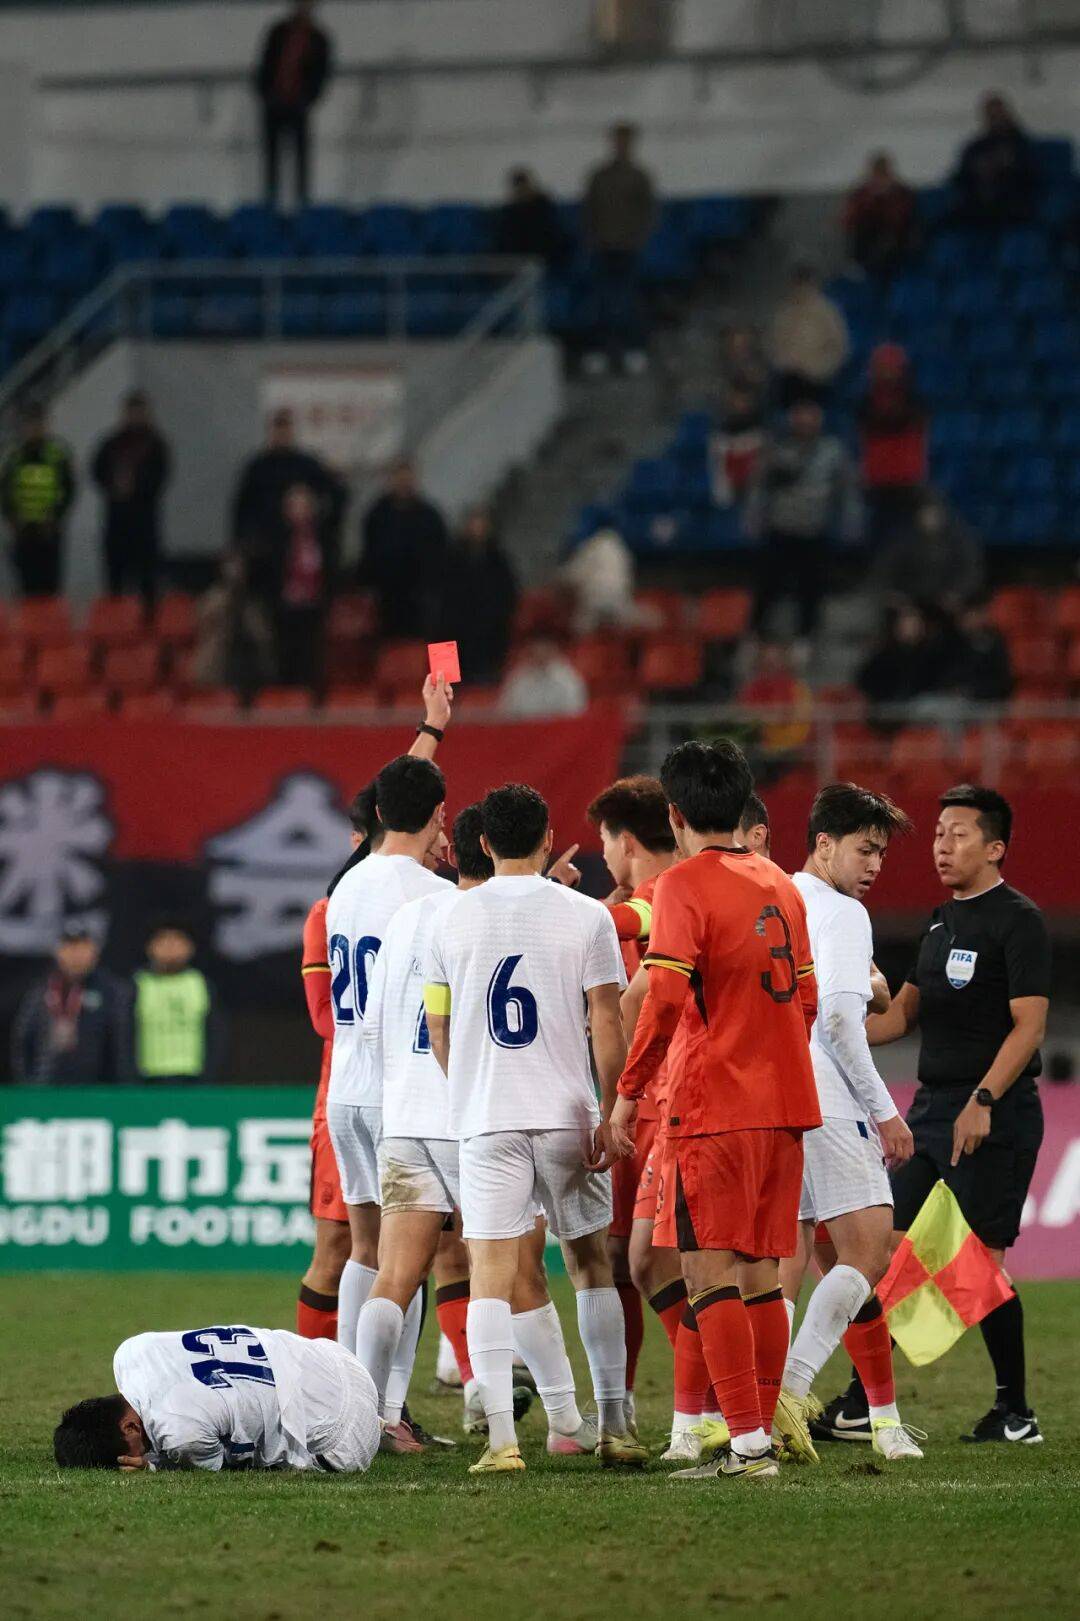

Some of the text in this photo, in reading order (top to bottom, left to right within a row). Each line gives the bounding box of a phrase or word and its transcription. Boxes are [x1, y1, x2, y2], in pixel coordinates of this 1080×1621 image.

[328, 933, 382, 1026] 20
[755, 904, 798, 1004] 3
[951, 952, 972, 963] FIFA
[486, 953, 538, 1050] 6
[181, 1326, 276, 1390] 13
